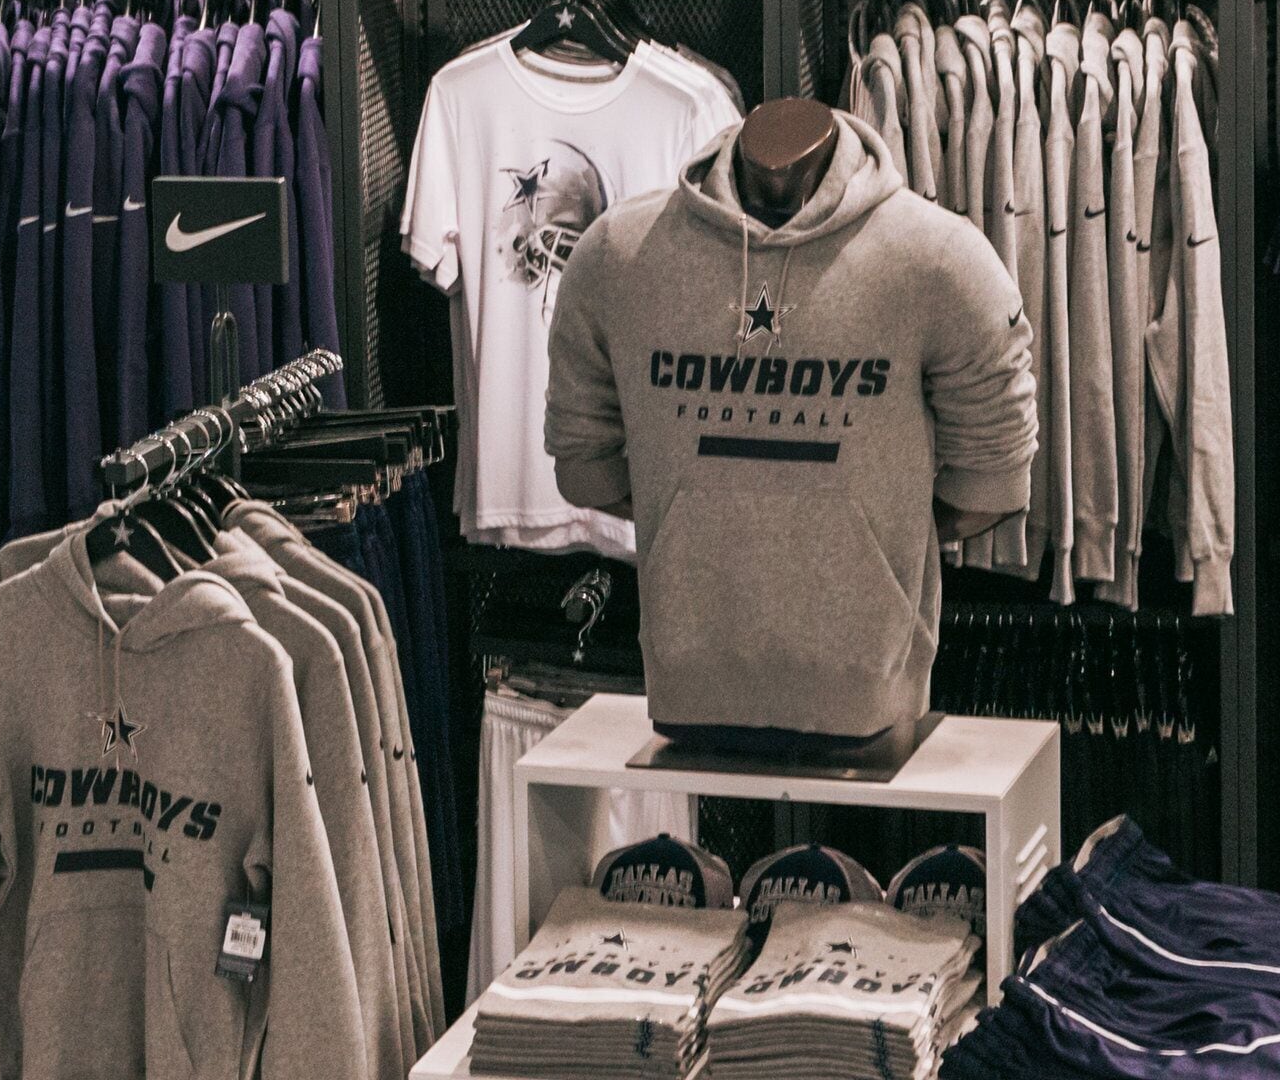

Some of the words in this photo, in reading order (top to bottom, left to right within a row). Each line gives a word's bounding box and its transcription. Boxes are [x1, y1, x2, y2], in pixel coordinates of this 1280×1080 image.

[650, 349, 891, 398] COWBOYS
[676, 404, 854, 428] FOOTBALL
[31, 763, 222, 841] COWBOYS
[611, 863, 695, 894] DALLAS
